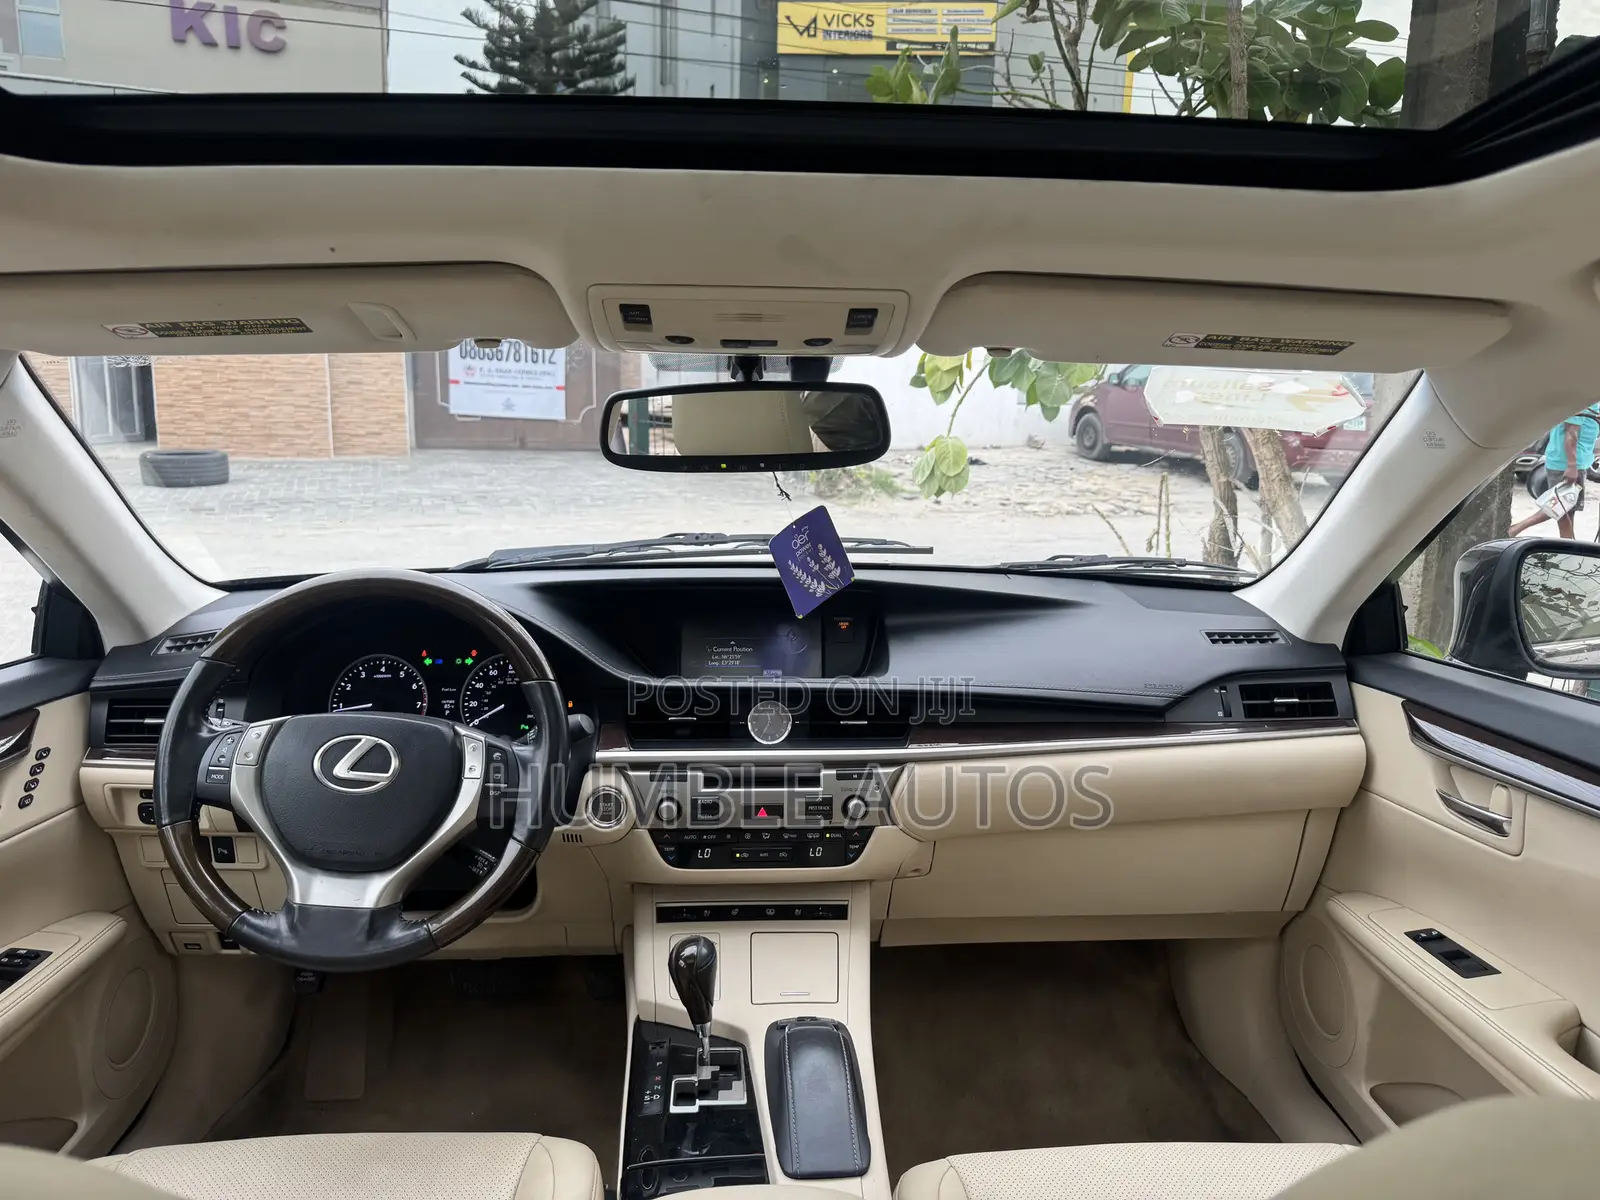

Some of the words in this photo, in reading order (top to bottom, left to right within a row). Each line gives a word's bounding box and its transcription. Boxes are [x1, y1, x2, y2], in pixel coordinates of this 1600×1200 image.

[823, 14, 875, 28] VICKS
[170, 0, 288, 53] KIC
[223, 318, 301, 326] WARNING
[1279, 338, 1353, 347] WARNING
[399, 670, 405, 678] 5
[697, 848, 712, 858] LO
[809, 846, 823, 857] LO
